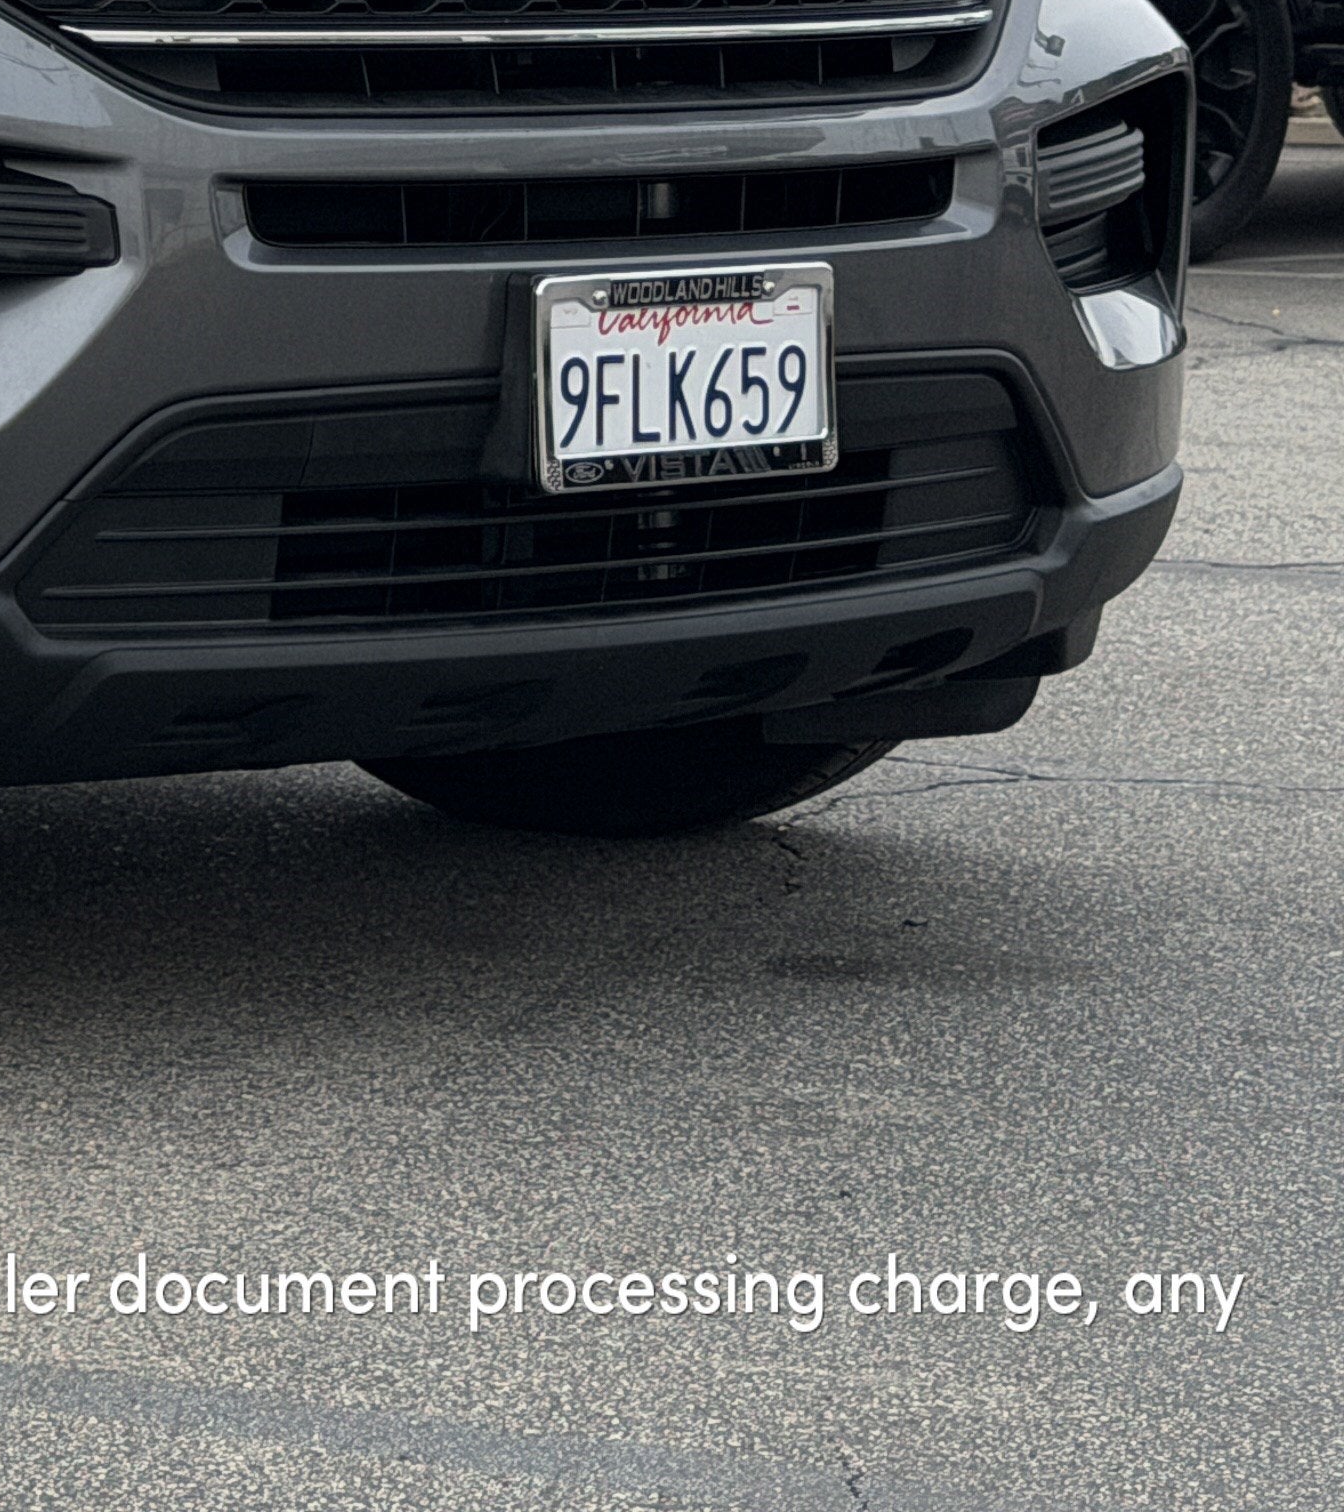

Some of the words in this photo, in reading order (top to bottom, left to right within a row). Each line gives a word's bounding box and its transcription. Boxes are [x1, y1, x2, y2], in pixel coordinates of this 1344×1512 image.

[613, 278, 712, 305] WOODLAND
[715, 275, 763, 299] HILLS
[597, 301, 775, 346] California
[560, 345, 807, 449] 9FLK659
[621, 448, 738, 483] VISTA
